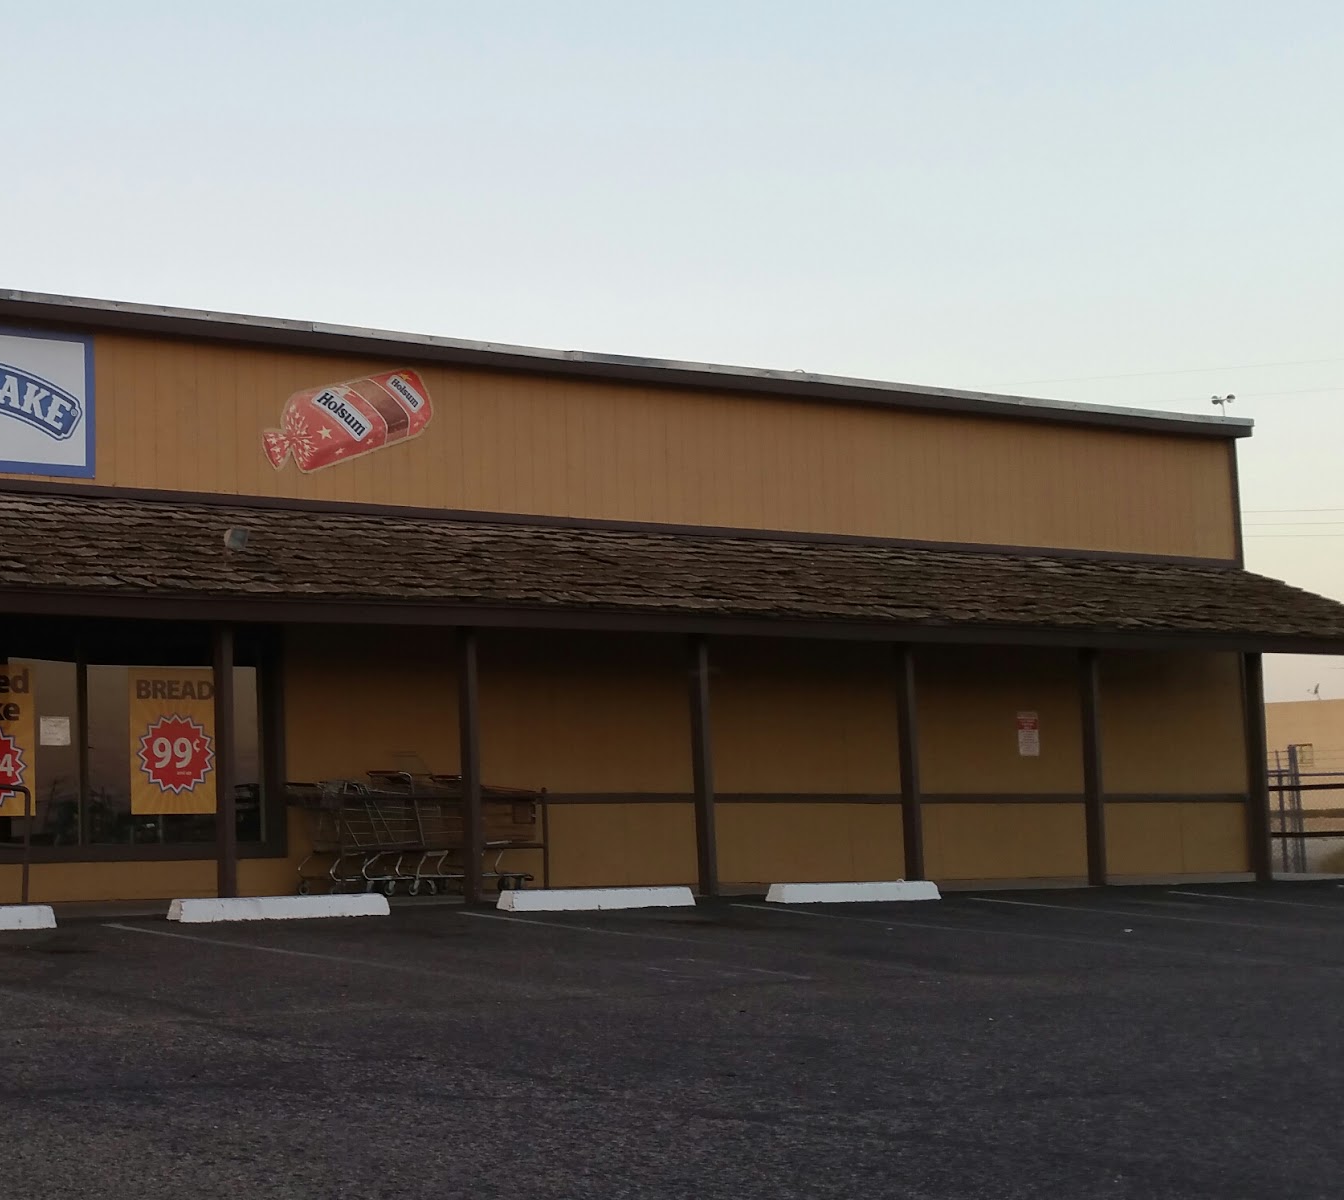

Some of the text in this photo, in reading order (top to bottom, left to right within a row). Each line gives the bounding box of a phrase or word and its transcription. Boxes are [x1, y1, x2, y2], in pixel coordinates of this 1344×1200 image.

[391, 378, 419, 409] Holsum
[317, 392, 368, 436] Holsum
[137, 680, 215, 700] BREAD
